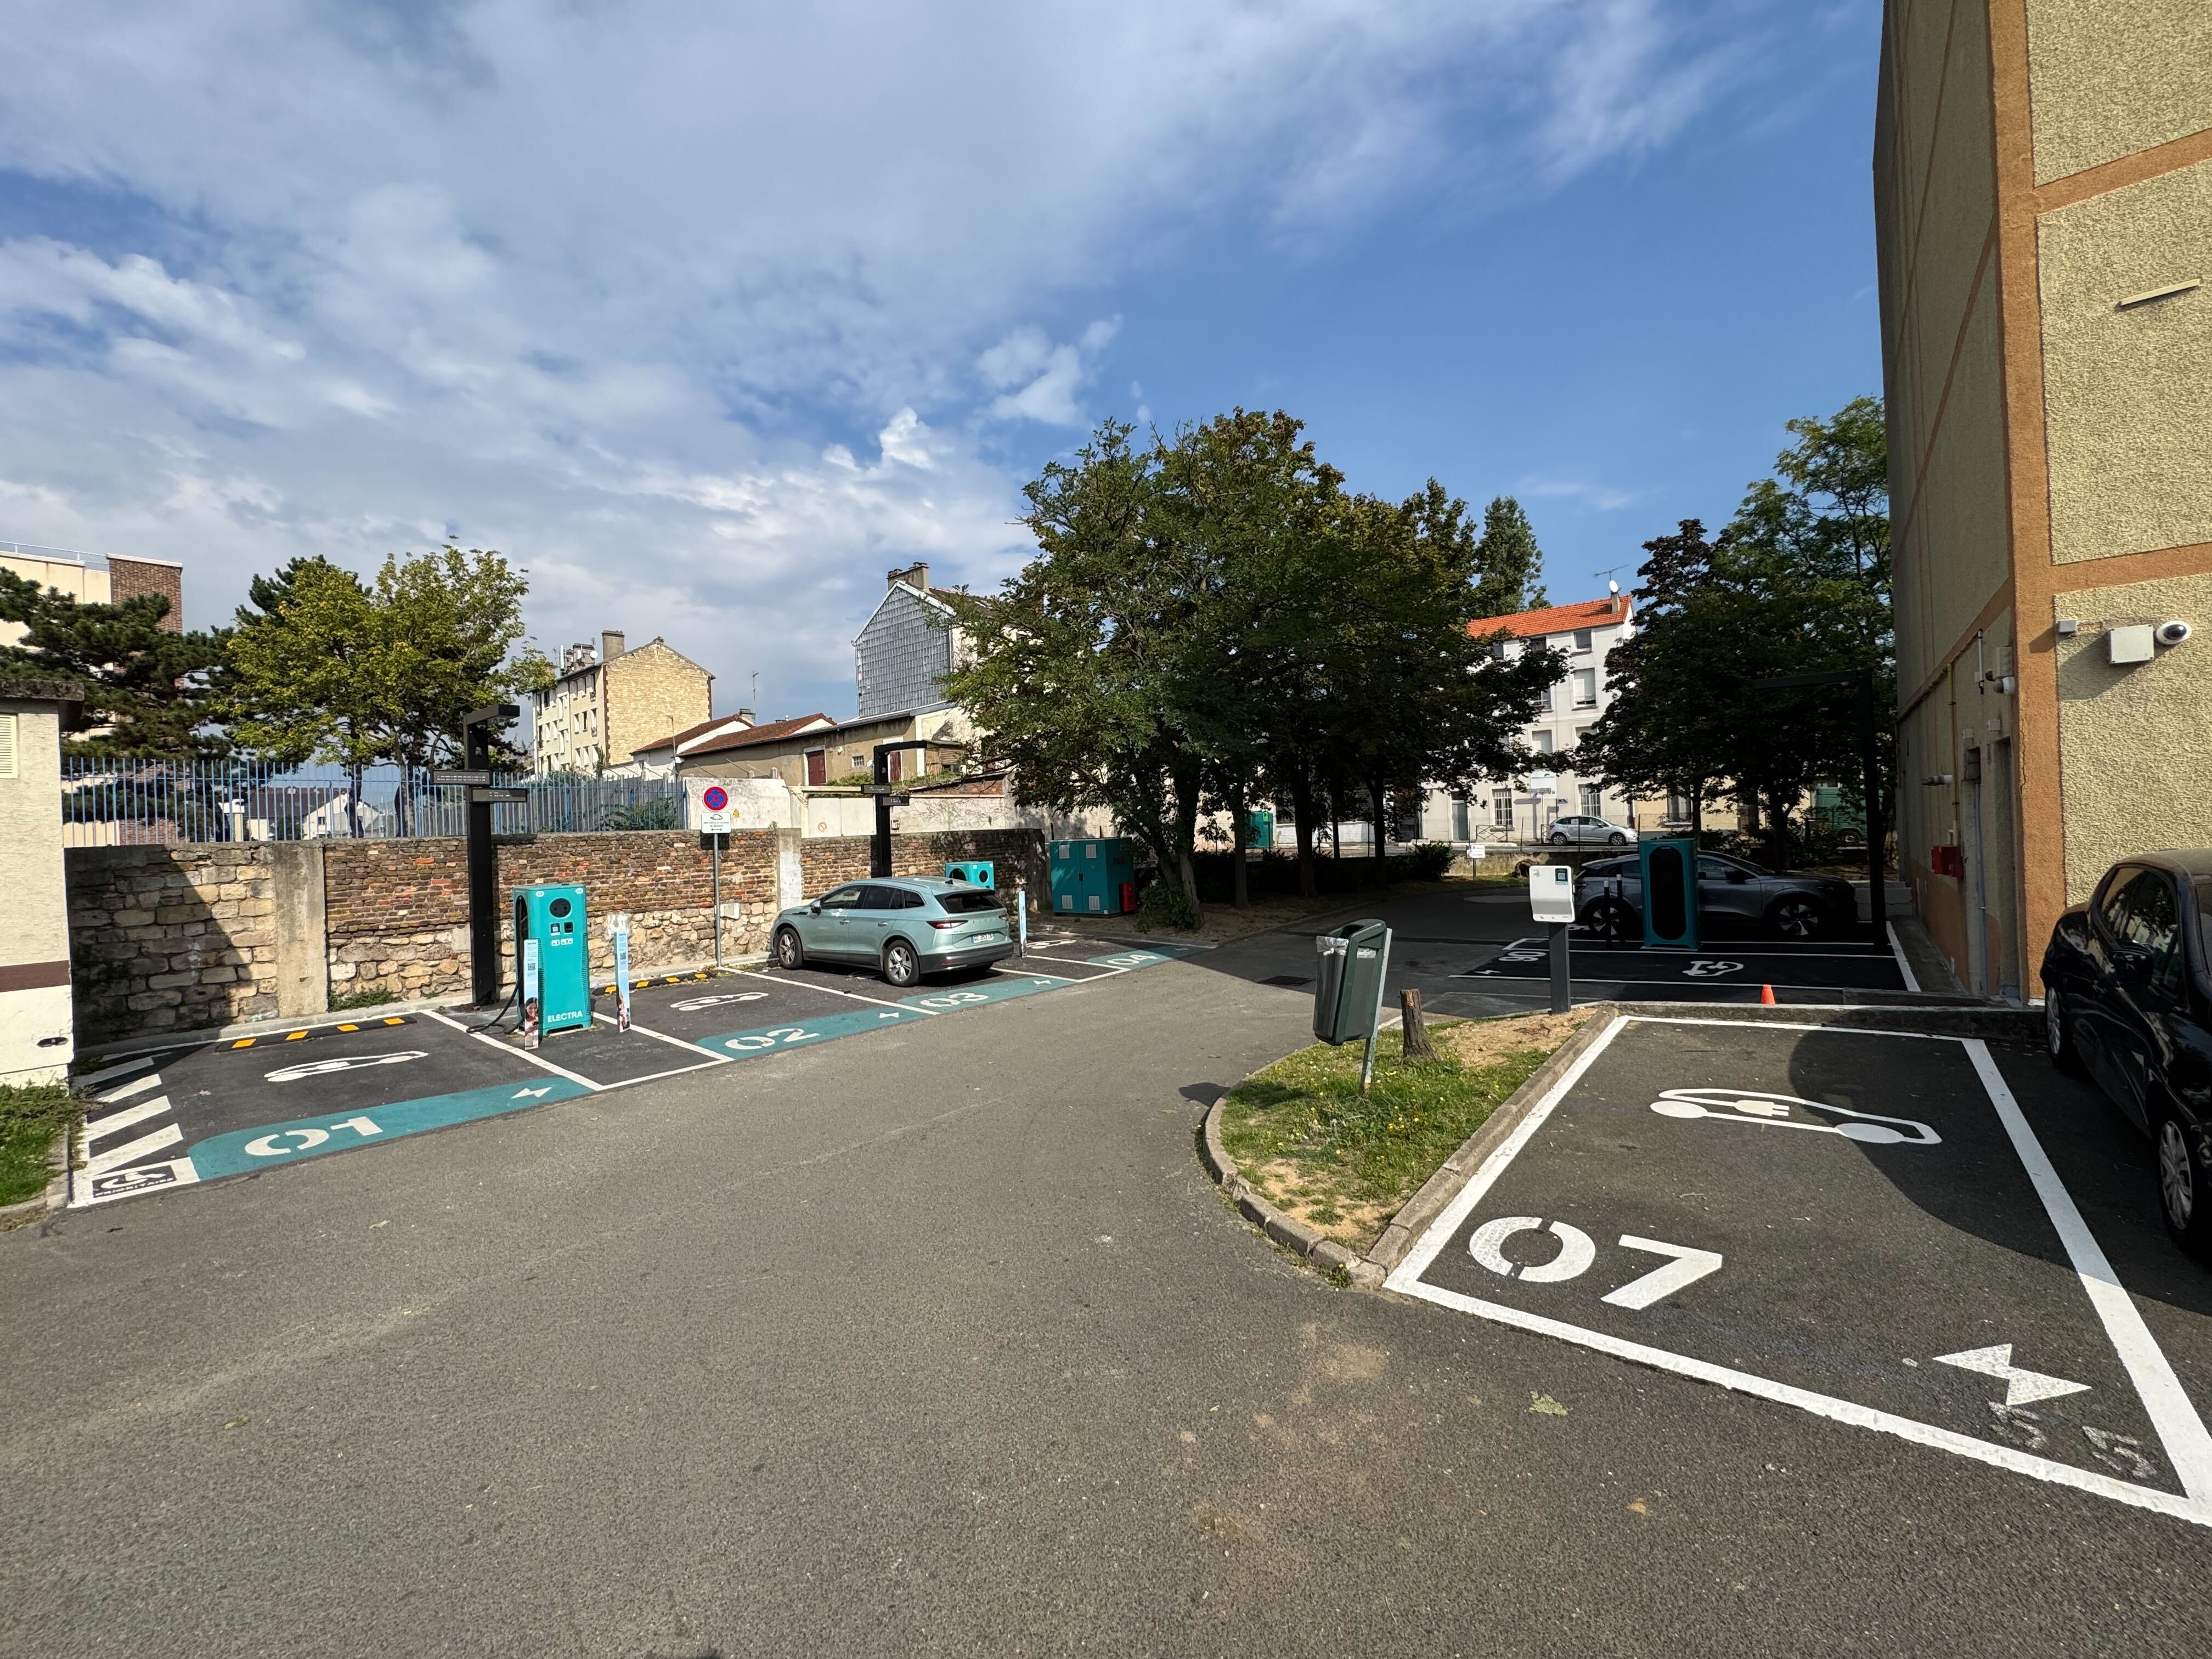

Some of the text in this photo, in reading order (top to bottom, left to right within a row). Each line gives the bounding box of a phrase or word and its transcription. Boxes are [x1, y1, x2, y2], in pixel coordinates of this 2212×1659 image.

[1107, 954, 1159, 965] 04
[919, 992, 989, 1008] 03
[548, 1011, 583, 1023] ELECTRA
[725, 1028, 821, 1050] 02
[245, 1116, 383, 1156] 01
[1469, 1216, 1723, 1311] 07
